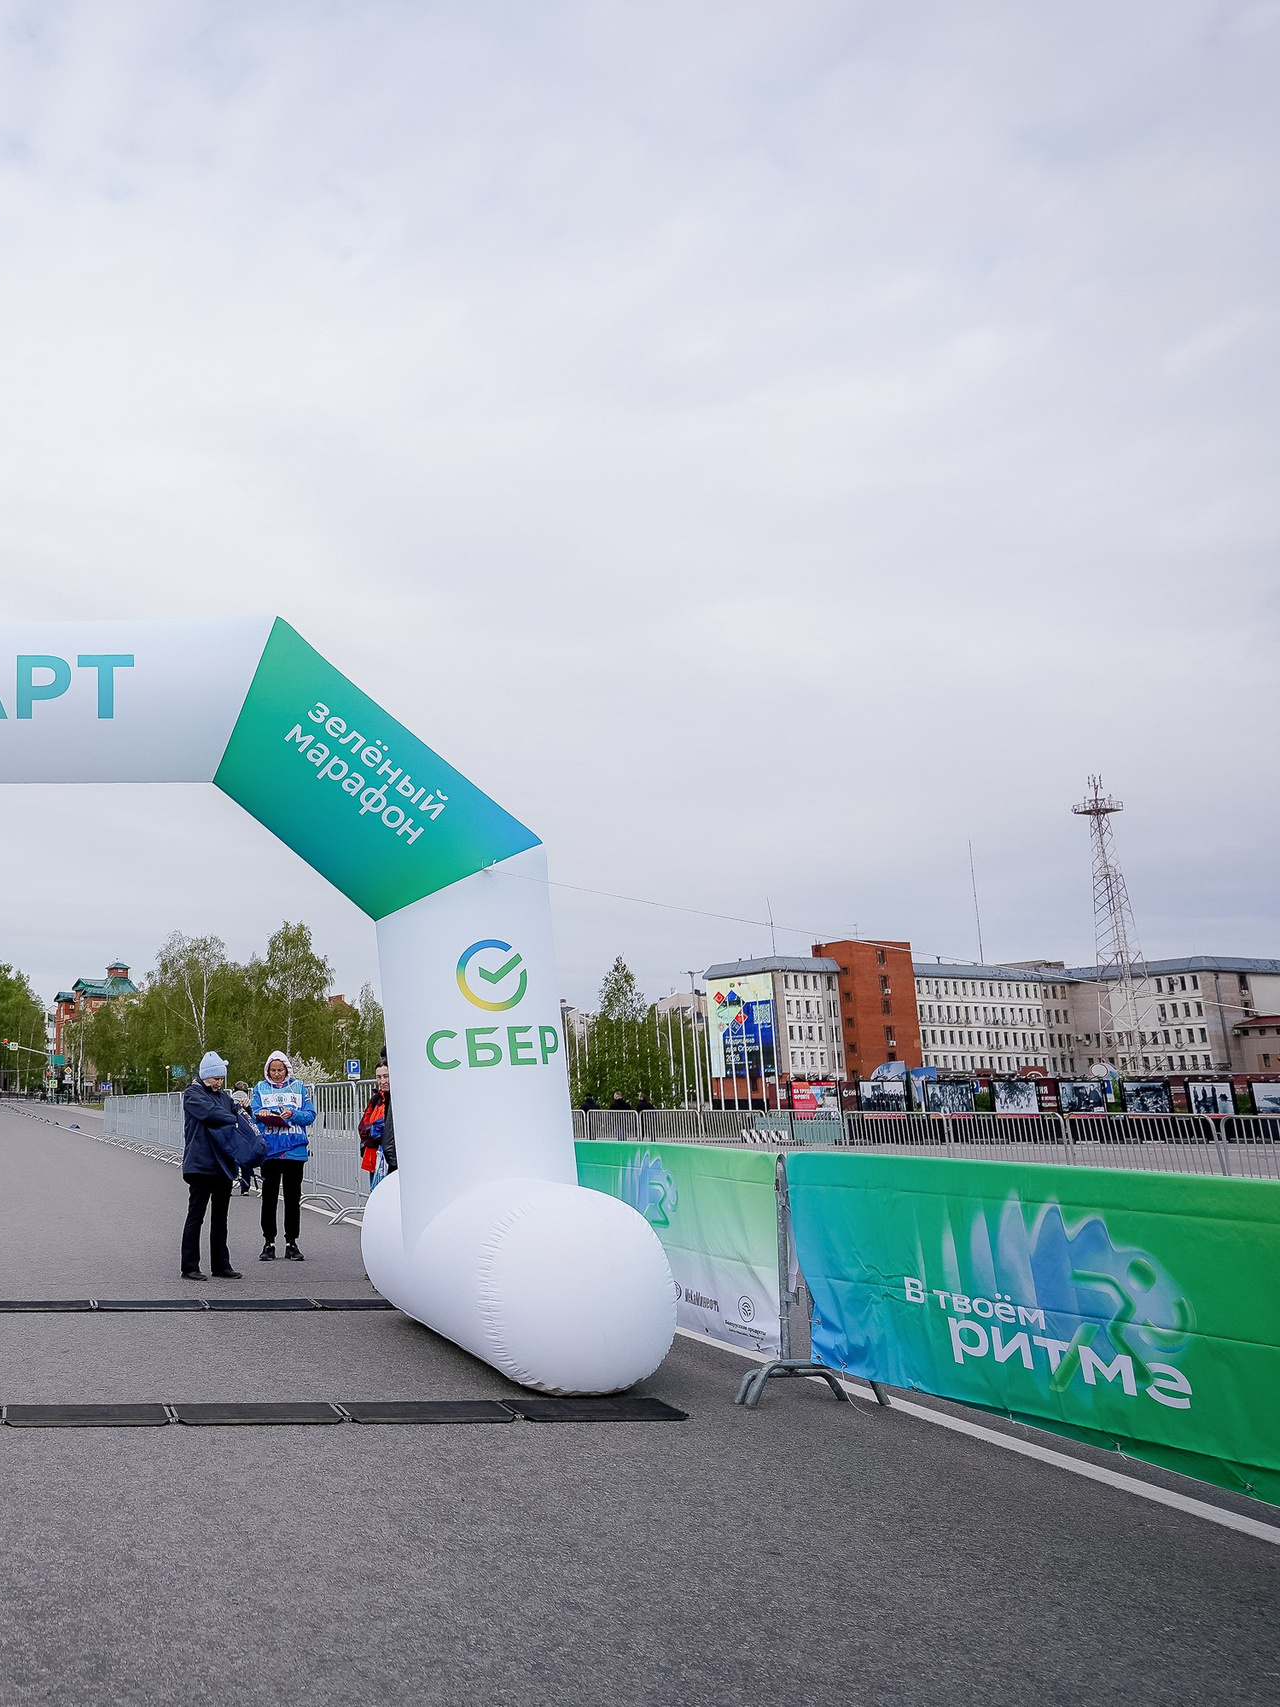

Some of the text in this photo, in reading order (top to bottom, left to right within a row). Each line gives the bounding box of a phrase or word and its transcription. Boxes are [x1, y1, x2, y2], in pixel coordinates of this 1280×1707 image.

[284, 722, 425, 846] марафон
[307, 701, 449, 821] зелёный
[426, 1025, 558, 1070] СБЕР
[903, 1277, 1046, 1330] В твоём
[948, 1316, 1194, 1410] ритме
